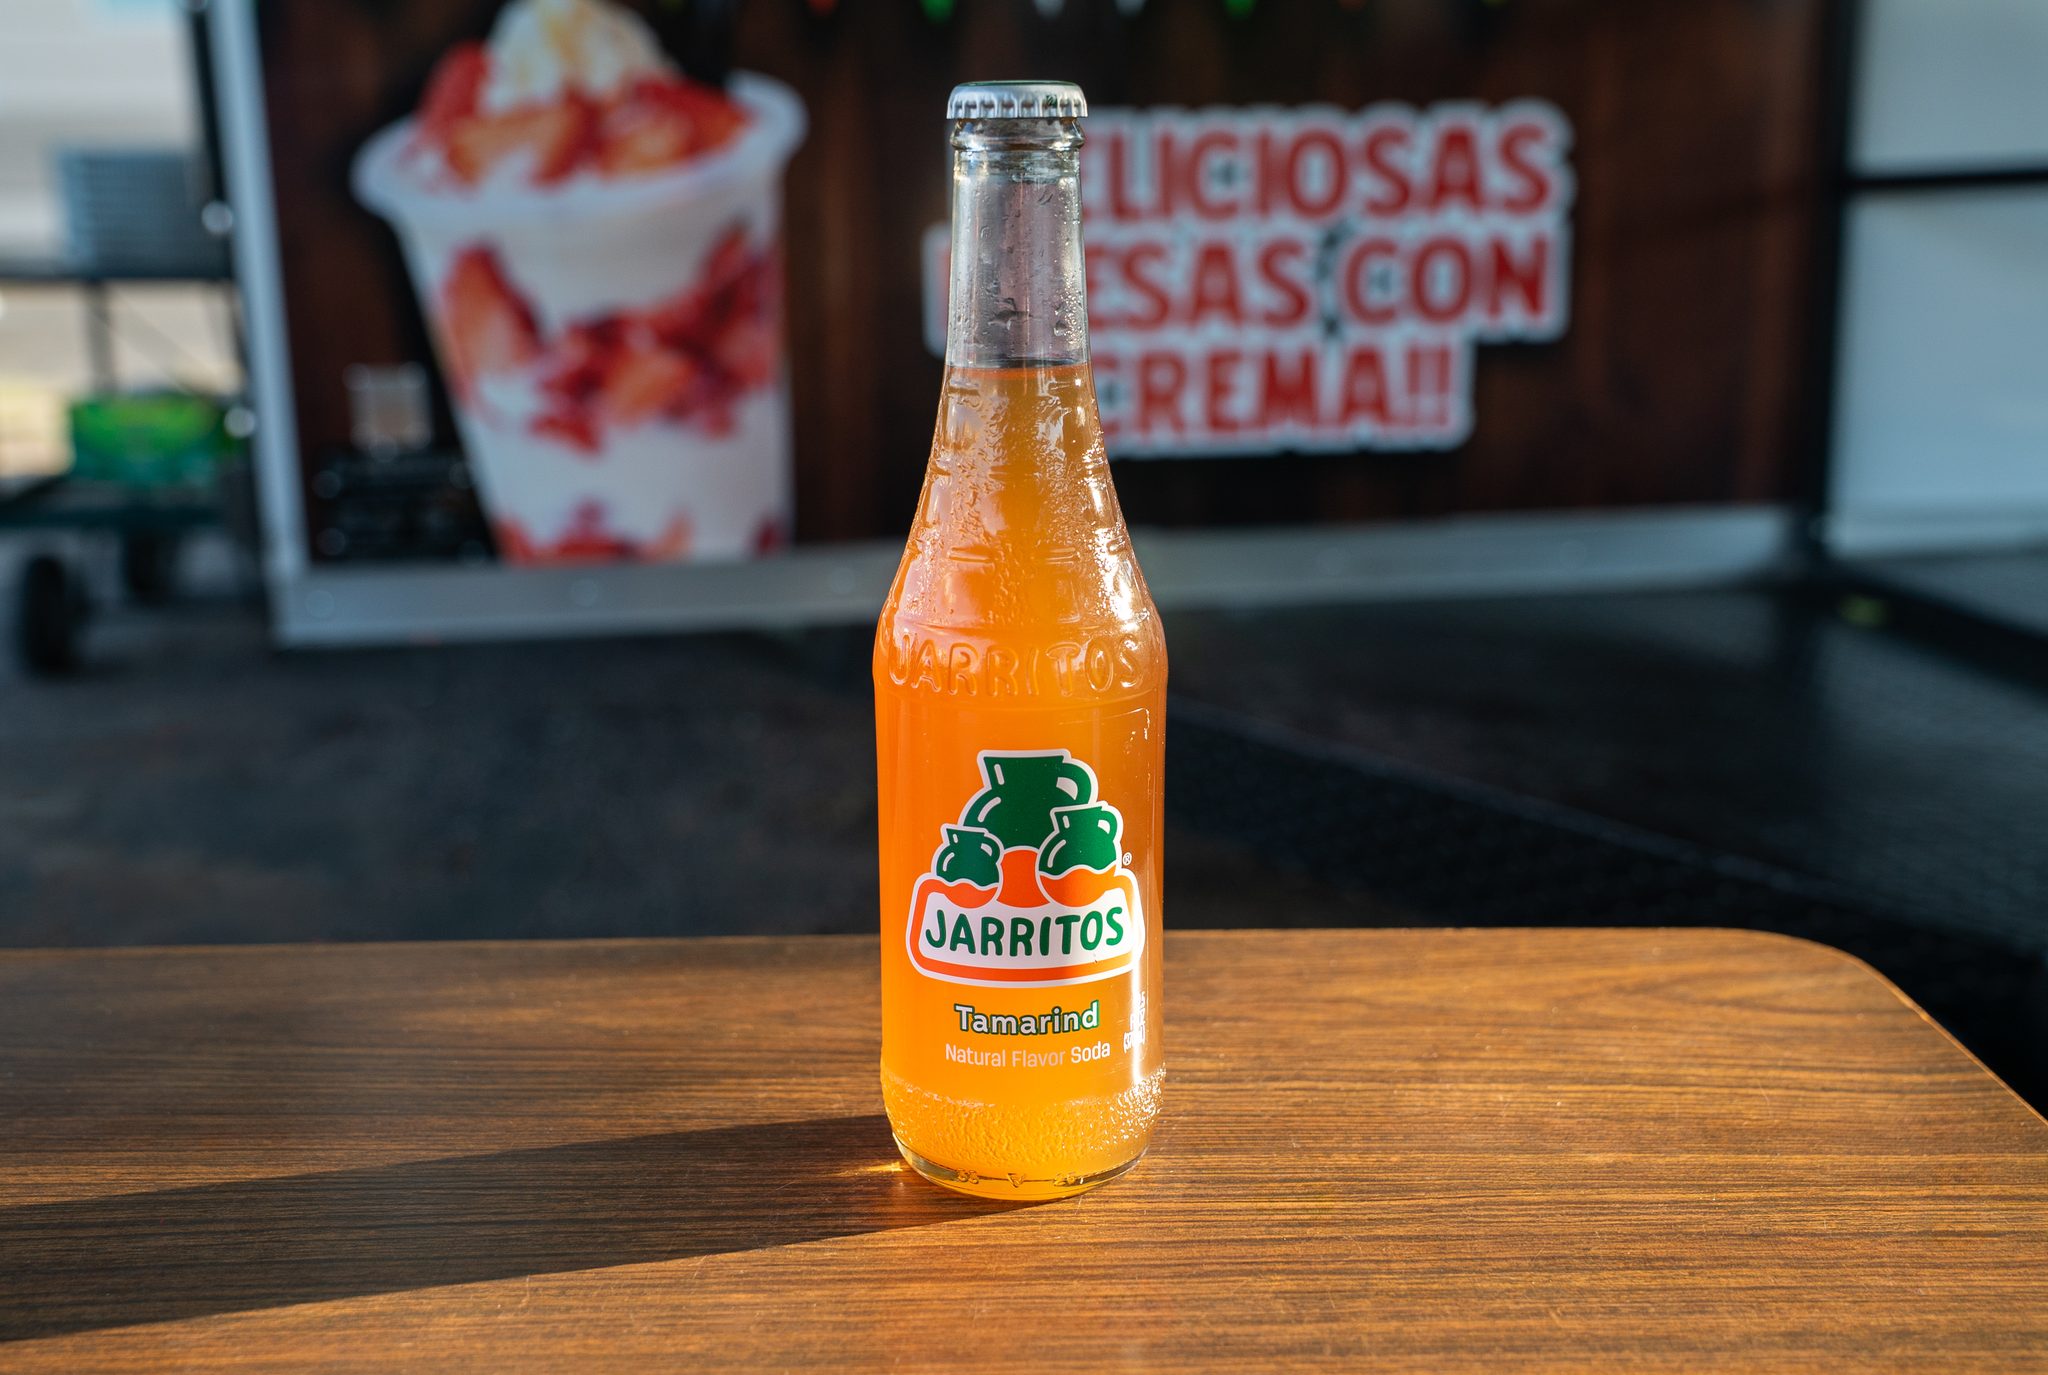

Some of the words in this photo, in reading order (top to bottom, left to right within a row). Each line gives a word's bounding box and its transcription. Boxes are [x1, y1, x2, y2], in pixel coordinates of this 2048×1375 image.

[1080, 122, 1552, 224] LICIOSAS
[1343, 236, 1547, 324] CON
[887, 632, 1146, 696] JARRITOS
[925, 906, 1124, 957] JARRITOS
[954, 999, 1100, 1036] Tamarind
[945, 1043, 1006, 1067] Natural
[1011, 1050, 1065, 1068] Flavor
[1070, 1040, 1111, 1063] Soda
